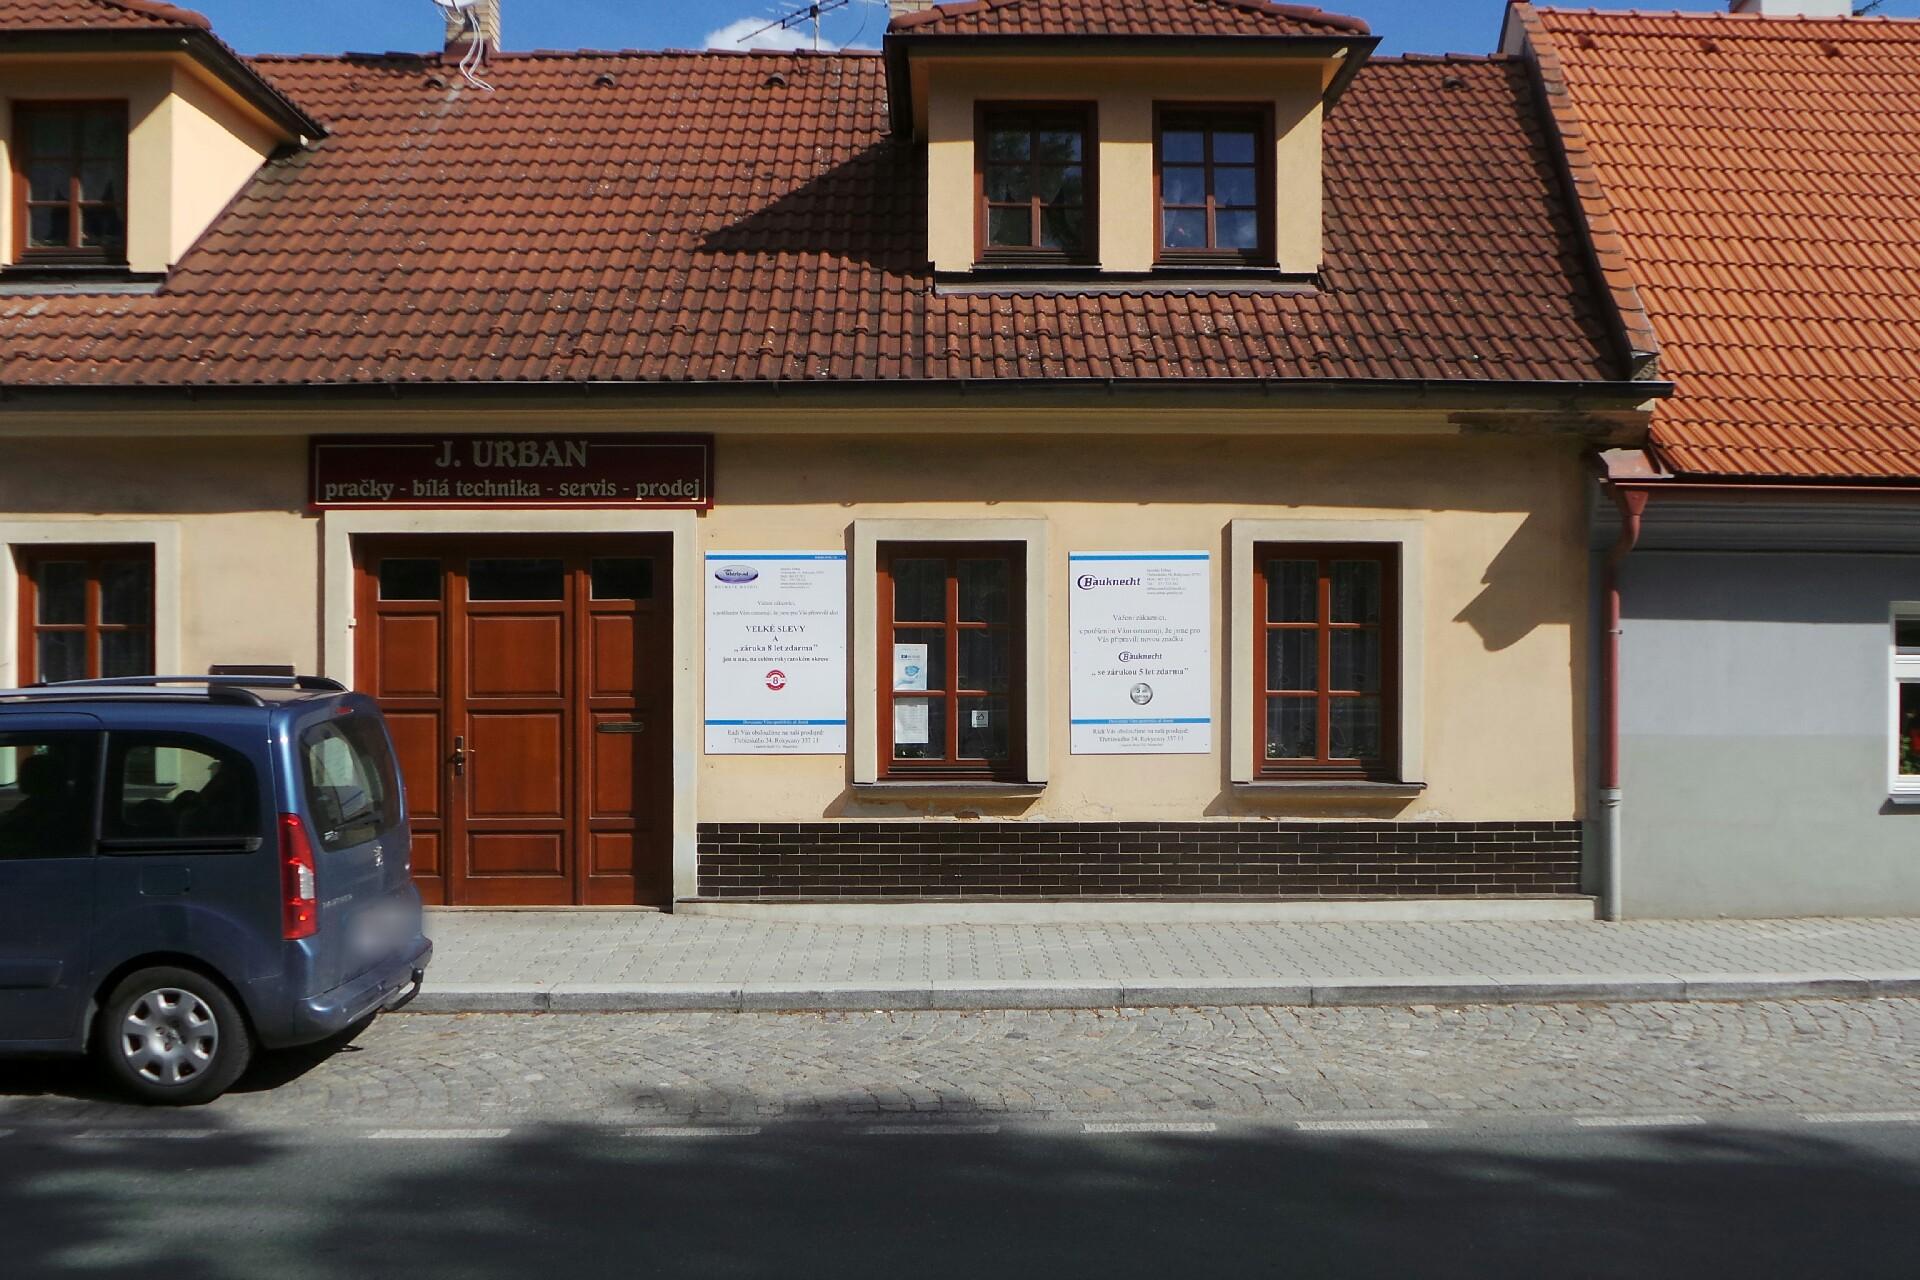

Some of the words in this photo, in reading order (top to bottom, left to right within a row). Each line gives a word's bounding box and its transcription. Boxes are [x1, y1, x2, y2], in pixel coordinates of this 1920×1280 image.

[435, 440, 461, 467] J.
[473, 440, 588, 467] URBAN
[325, 479, 394, 500] pračky
[413, 478, 449, 497] bílá
[456, 479, 540, 497] technika
[559, 479, 616, 497] servis
[636, 479, 700, 501] prodej
[1078, 575, 1141, 589] Bauknecht
[745, 624, 775, 633] VELKÉ
[777, 625, 806, 633] SLEVY
